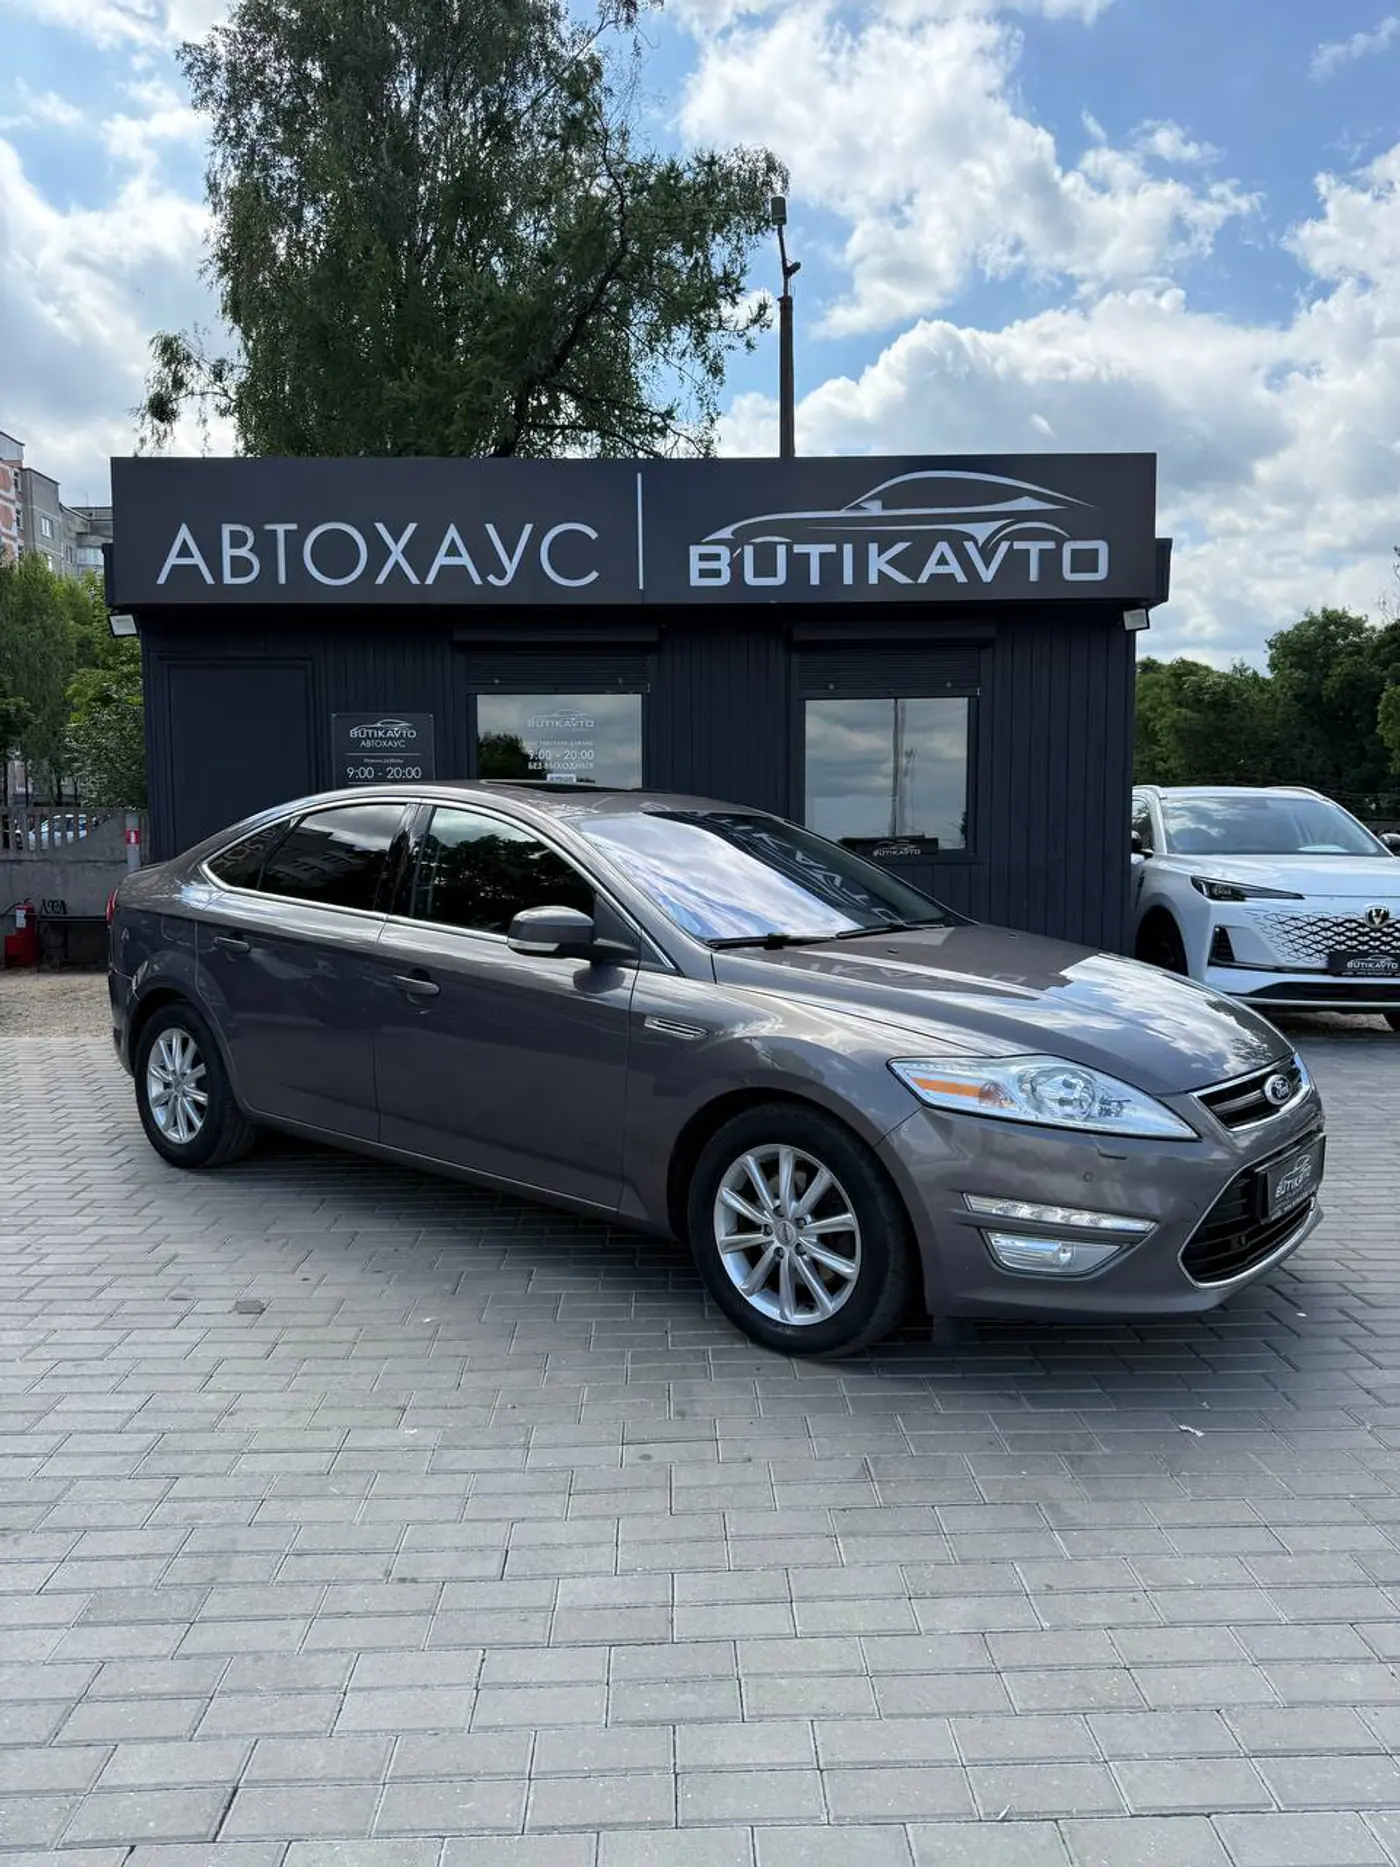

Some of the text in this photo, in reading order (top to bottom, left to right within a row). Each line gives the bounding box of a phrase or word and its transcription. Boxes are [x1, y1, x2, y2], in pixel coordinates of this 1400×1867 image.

[156, 521, 599, 588] АВТОХАУС
[689, 539, 1109, 587] BUTIKAVTO
[349, 728, 417, 738] BUTIKAVTO
[360, 739, 406, 748] АВТОХАУС
[528, 749, 551, 760] 9:00
[564, 749, 595, 760] 20:00
[346, 766, 374, 779] 9:00
[386, 766, 421, 779] 20:00
